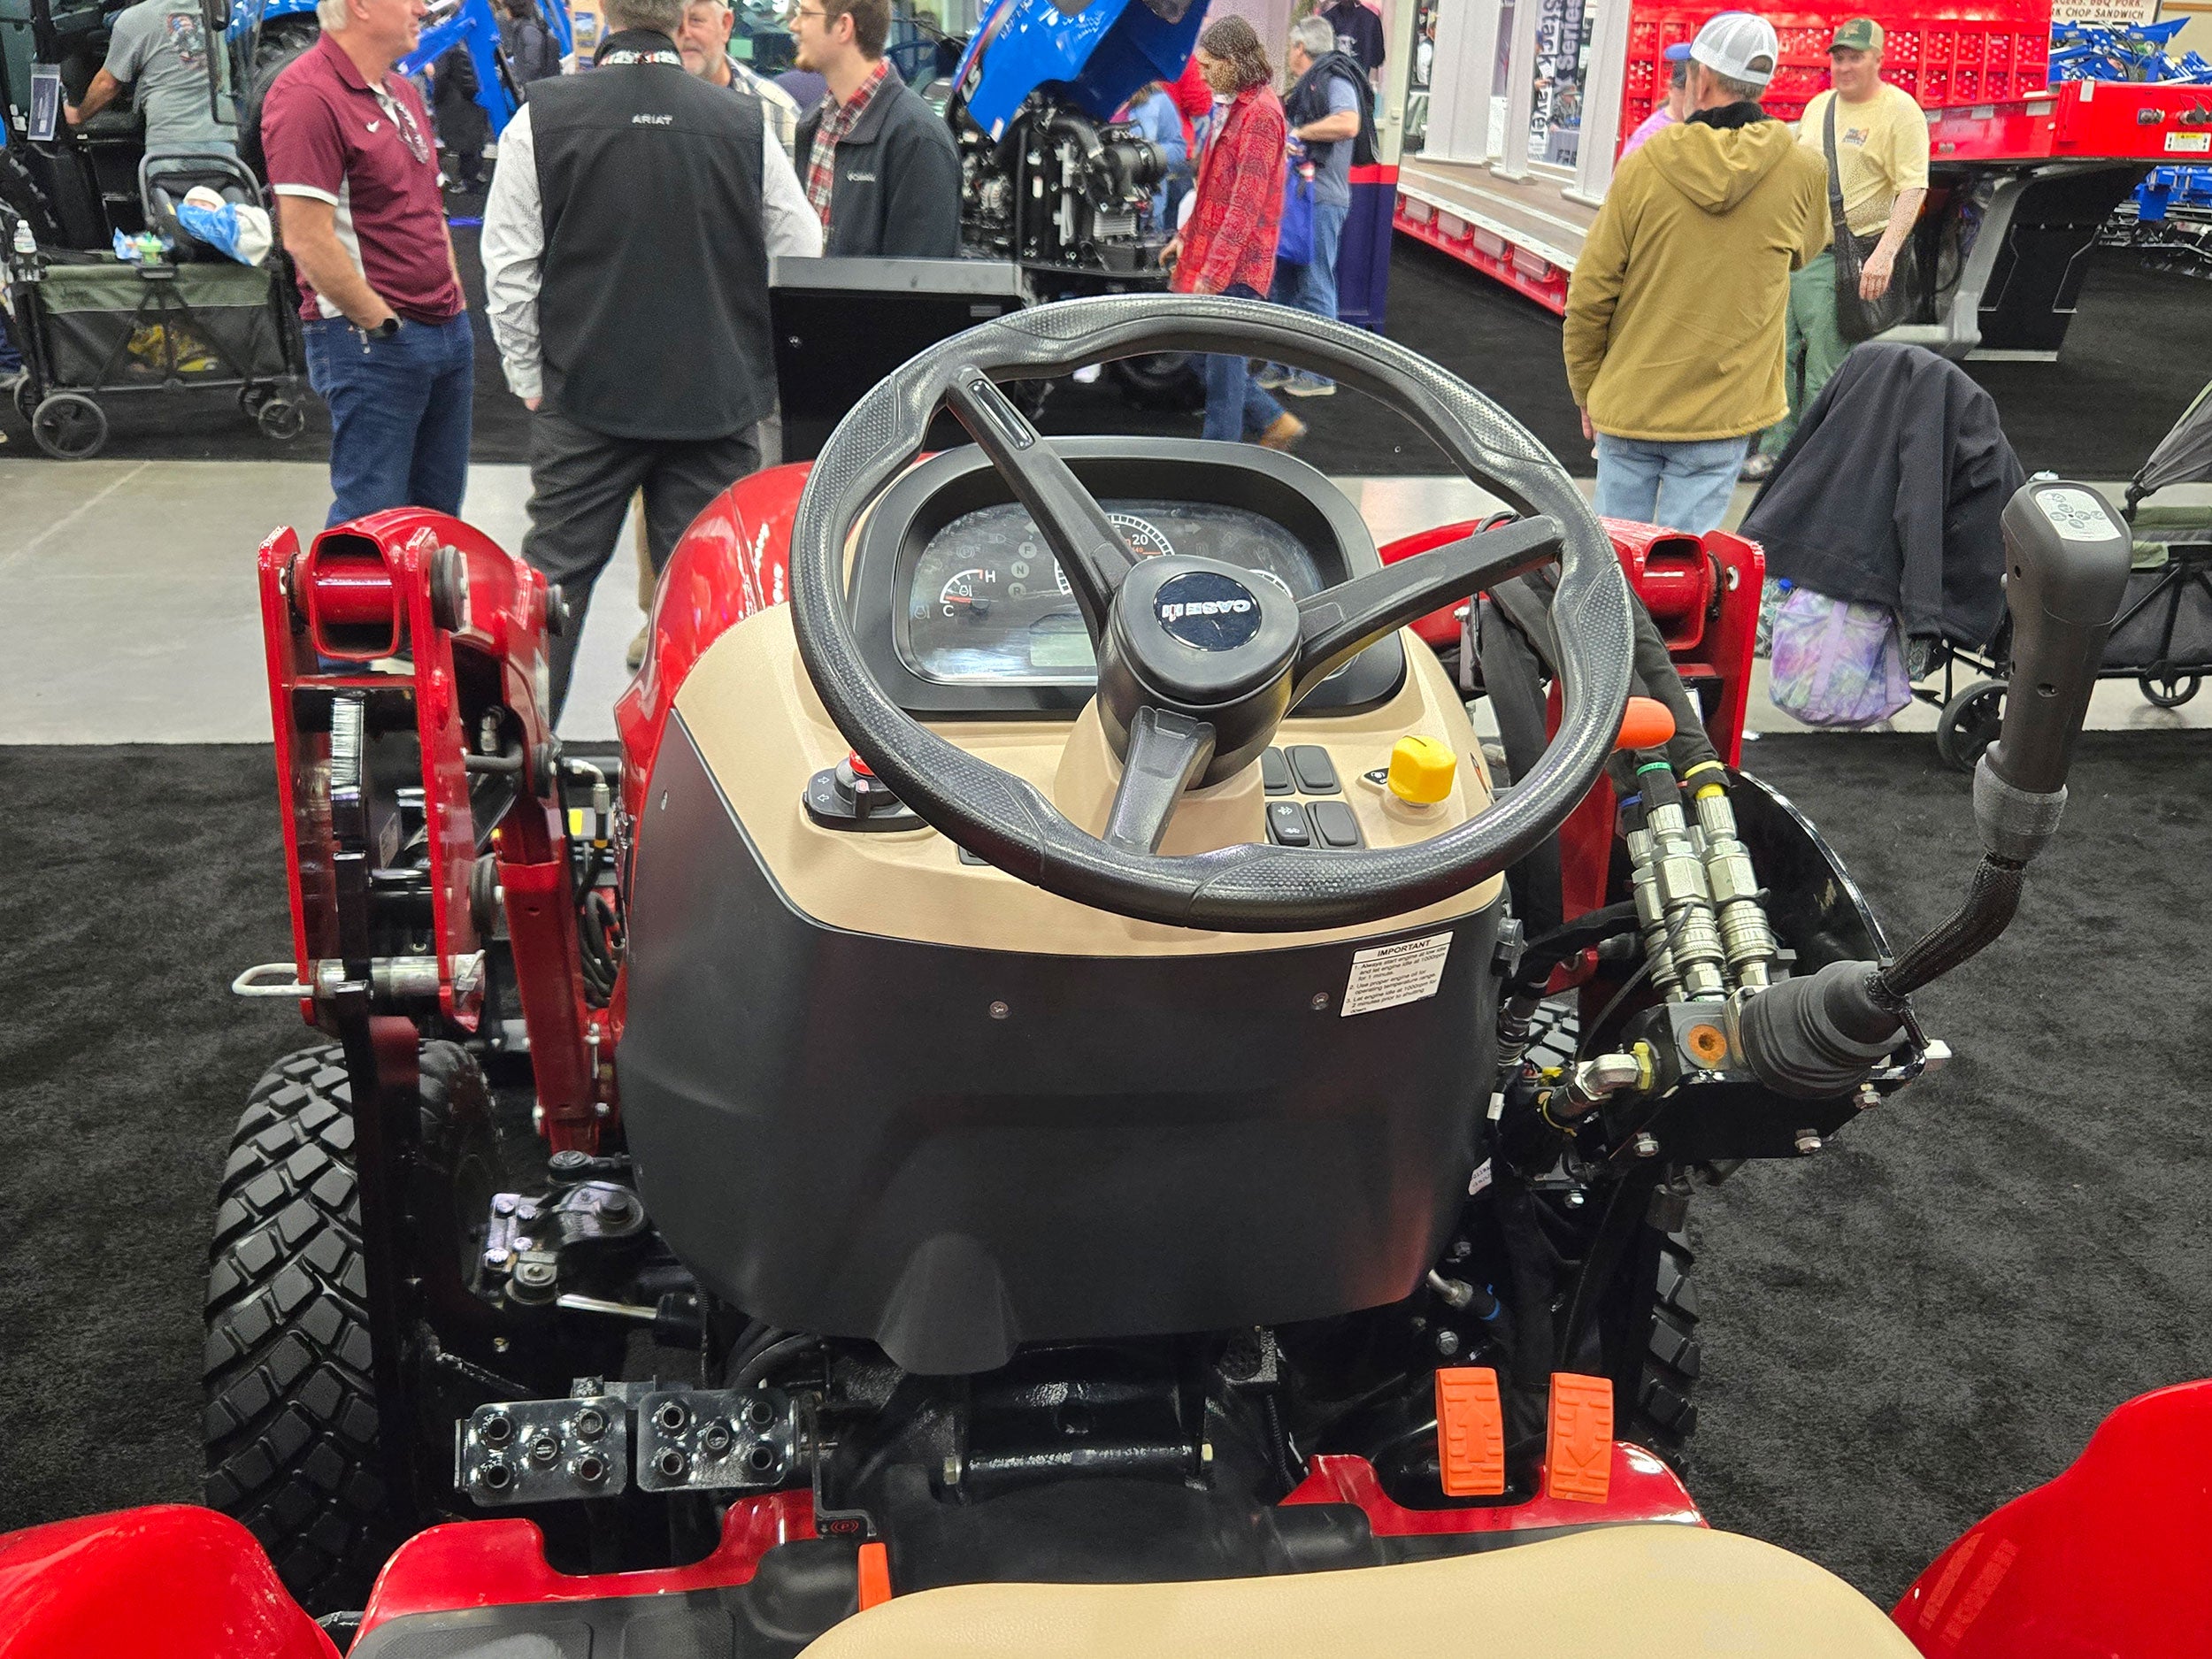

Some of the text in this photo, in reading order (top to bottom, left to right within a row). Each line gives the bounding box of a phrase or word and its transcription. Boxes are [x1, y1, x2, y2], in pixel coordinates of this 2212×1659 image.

[2065, 7, 2092, 17] CHOP
[2094, 8, 2145, 19] SANDWICH
[1536, 0, 1561, 66] Stack
[632, 113, 672, 125] ARIAT
[1132, 534, 1149, 545] 20
[985, 570, 996, 583] H
[942, 604, 955, 618] C
[1185, 599, 1251, 617] CASE
[1377, 940, 1431, 956] IMPORTANT
